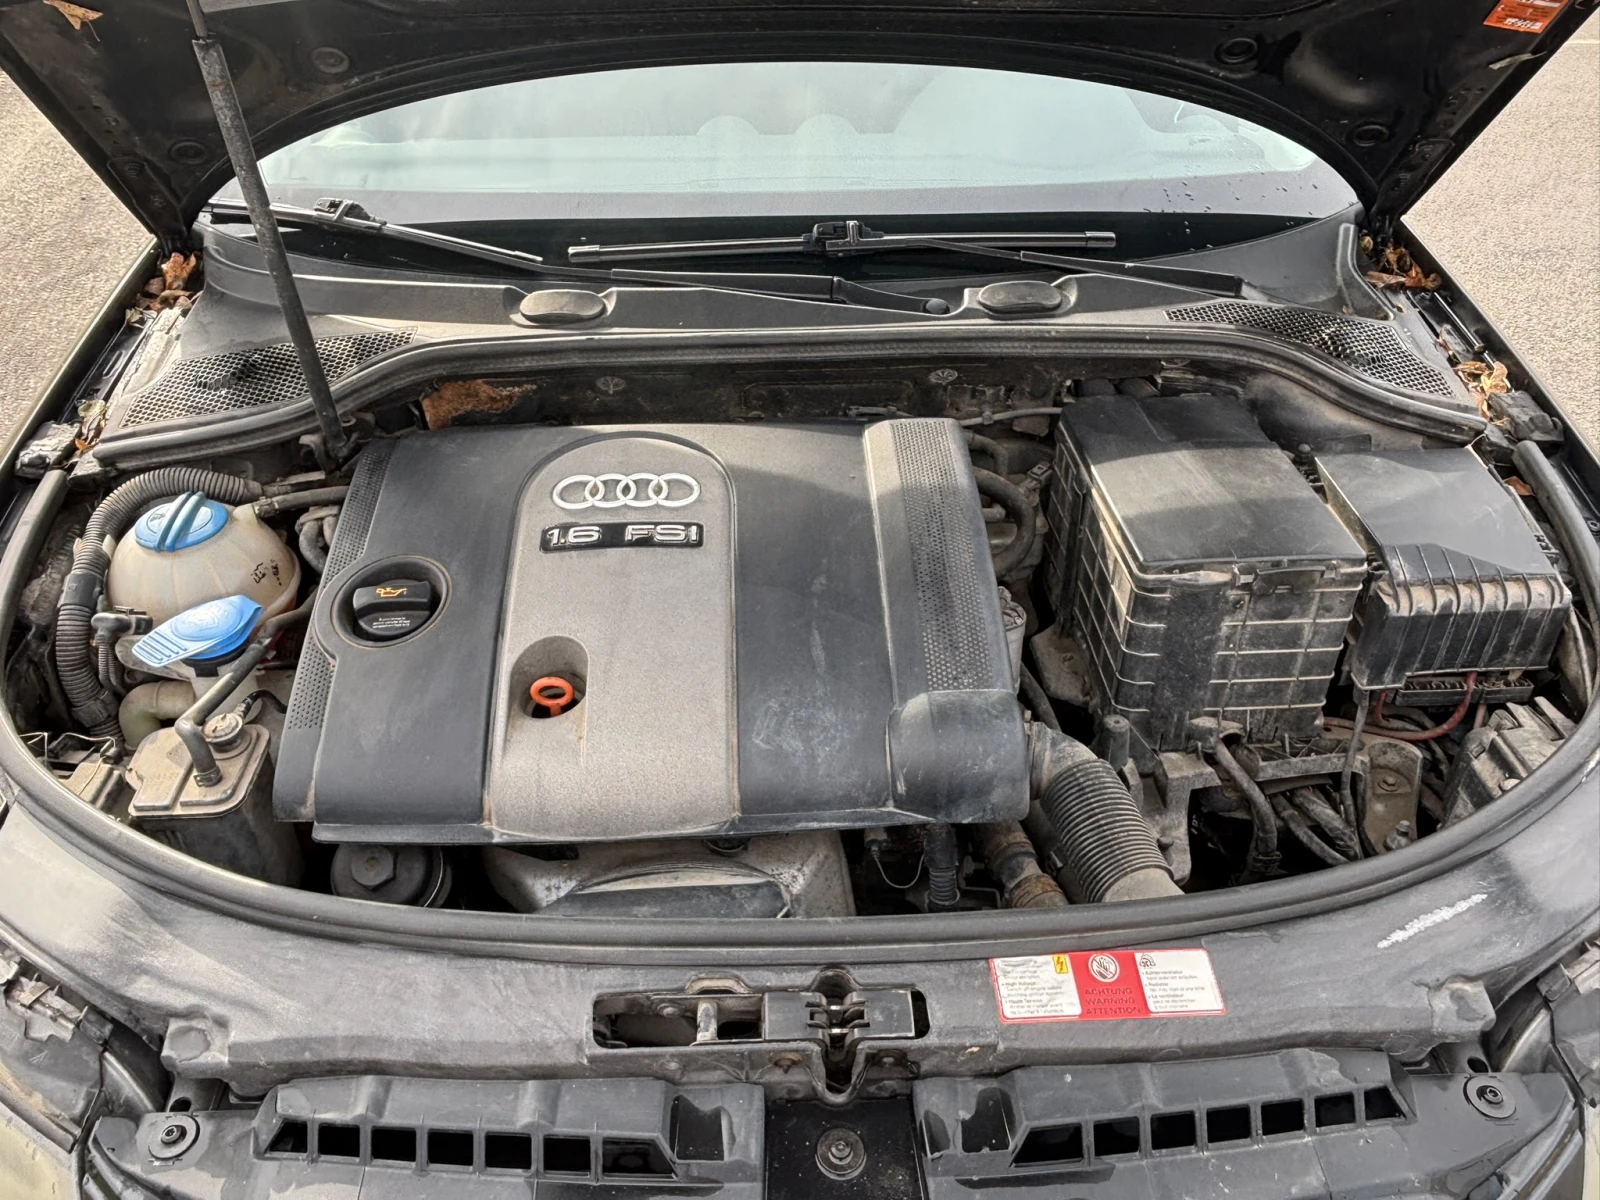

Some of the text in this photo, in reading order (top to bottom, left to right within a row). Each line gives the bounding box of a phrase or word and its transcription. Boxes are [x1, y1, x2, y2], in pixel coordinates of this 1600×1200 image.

[546, 524, 700, 546] 1.6 FSI
[1085, 987, 1133, 995] ACHTUNG
[1085, 997, 1136, 1006] WARNING
[1086, 1006, 1142, 1015] ATTENTION
